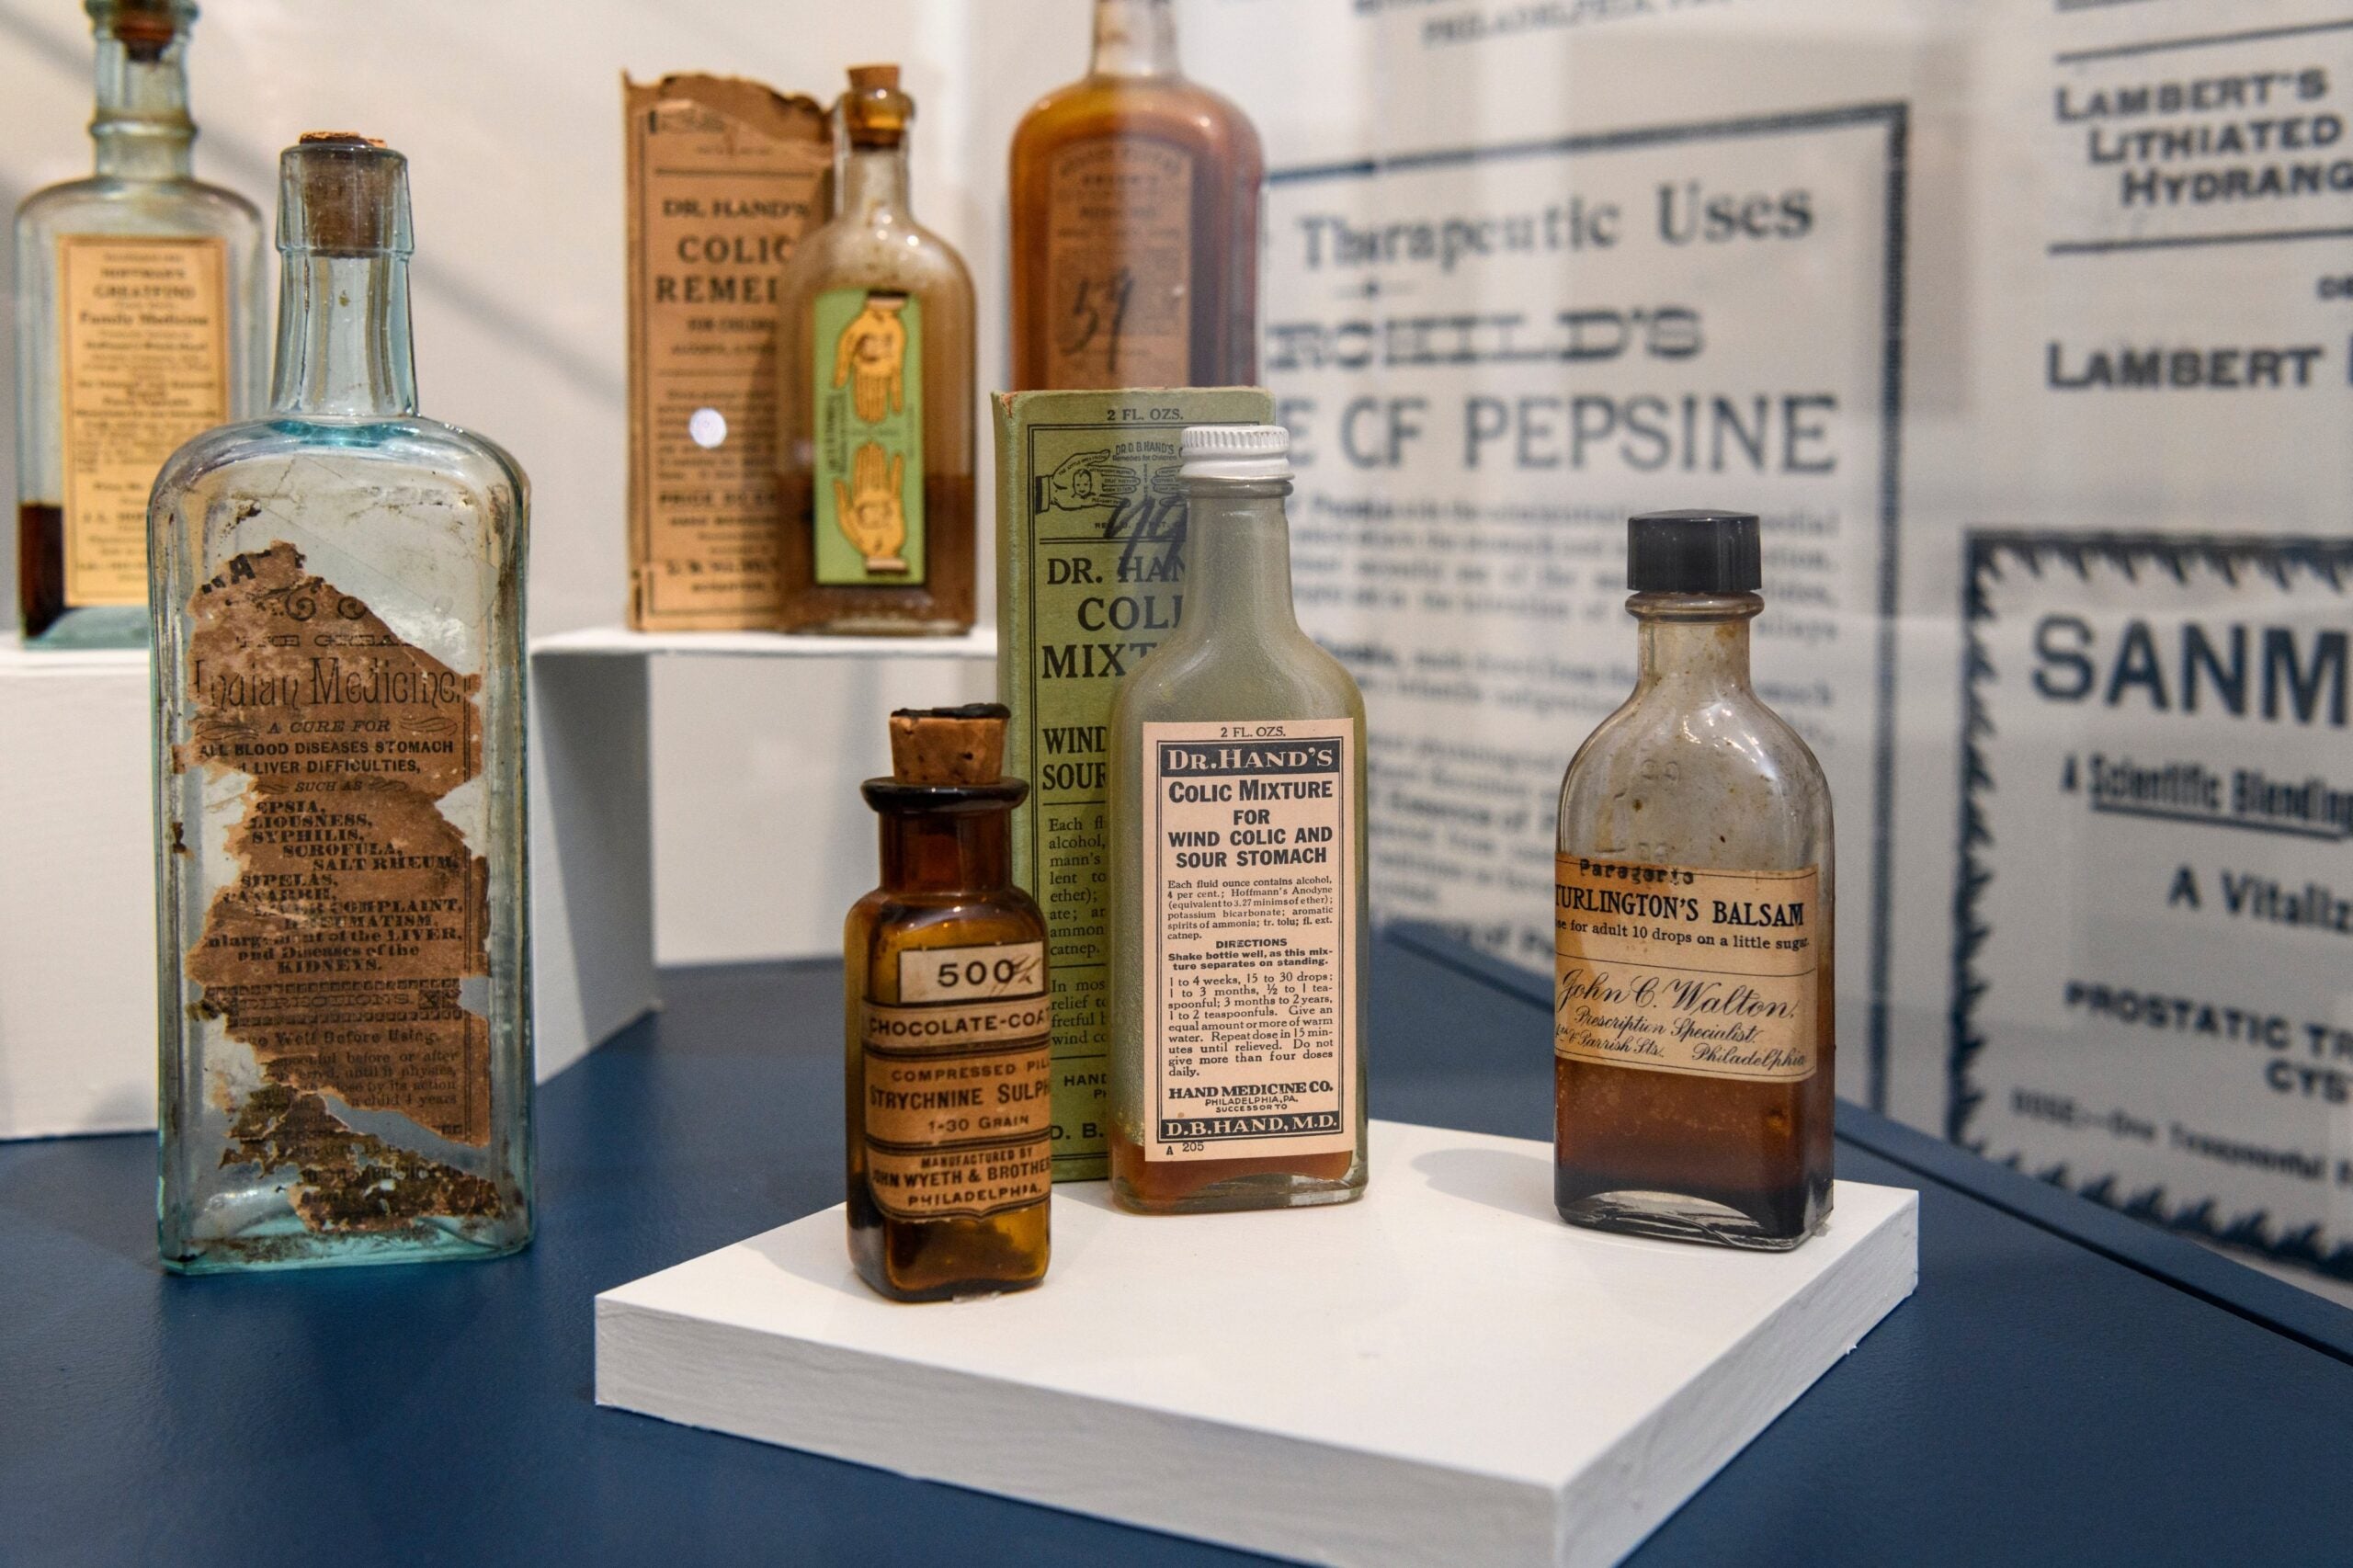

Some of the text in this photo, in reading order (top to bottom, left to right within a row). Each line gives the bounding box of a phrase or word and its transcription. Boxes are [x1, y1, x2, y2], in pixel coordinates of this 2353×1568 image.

[2054, 67, 2328, 122] LAMBERT'S
[2088, 114, 2343, 165] LITHIATED
[1298, 181, 1816, 273] Therapeutic Uses
[676, 235, 794, 265] COLIC
[2045, 340, 2325, 390] LAMBERT
[1108, 408, 1184, 421] 2 FL. OZS.
[1462, 392, 1838, 474] PEPSINE
[1048, 558, 1103, 585] DR.
[2031, 613, 2350, 729] SANM
[267, 720, 391, 734] A CURE FOR
[1221, 726, 1286, 738] 2 FL. OZS.
[234, 741, 289, 756] BLOOD
[295, 742, 369, 755] DISEASES
[375, 740, 453, 754] STOMACH
[255, 759, 421, 775] LIVER DIFFICULTIES,
[295, 782, 335, 793] SUCH
[2088, 752, 2224, 811] Scientific
[1169, 779, 1333, 803] COLIC MIXTURE
[1049, 818, 1083, 832] Each
[1233, 810, 1270, 825] FOR
[1049, 835, 1105, 850] alcohol,
[1168, 826, 1333, 847] WIND COLIC AND
[313, 858, 366, 871] SALT
[1050, 853, 1101, 867] mann's
[1176, 847, 1326, 868] SOUR STOMACH
[1050, 872, 1077, 885] lent
[1168, 881, 1192, 889] Each
[1197, 880, 1218, 888] fluid
[1254, 878, 1292, 887] contains
[1296, 876, 1332, 885] alcohol,
[1051, 888, 1097, 903] ether);
[1177, 892, 1192, 900] per
[1232, 888, 1288, 897] Hoffmann's
[1292, 887, 1332, 895] Anodyne
[1168, 901, 1222, 910] (equivalent
[1234, 899, 1252, 907] 3.27
[1555, 884, 1804, 927] TURLINGTON'S BALSAM
[1167, 907, 1333, 920] potassium bicarbonate; aromatic
[1167, 922, 1198, 930] spirits
[1199, 921, 1211, 929] of
[1212, 920, 1259, 928] ammonia;
[1278, 918, 1299, 926] tolu;
[1315, 916, 1332, 925] ext.
[1167, 932, 1202, 940] catnep.
[1571, 920, 1589, 933] for
[1592, 924, 1628, 937] adult
[1632, 926, 1647, 938] 10
[1652, 926, 1692, 946] drops
[1697, 935, 1714, 946] on
[1721, 937, 1728, 947] a
[1733, 935, 1770, 949] little
[1050, 943, 1099, 959] catnep.
[1216, 938, 1287, 949] DIRECTIONS
[1206, 951, 1238, 960] bottle
[1242, 949, 1267, 960] well,
[1285, 949, 1306, 957] this
[1310, 948, 1333, 956] mix-
[1173, 962, 1197, 971] ture
[1200, 960, 1256, 970] separates
[1278, 958, 1328, 966] standing.
[938, 959, 1015, 987] 500
[1558, 969, 1630, 1012] John
[1630, 974, 1659, 1009] C.
[1051, 996, 1088, 1010] relief
[1051, 1013, 1095, 1028] fretful
[2064, 979, 2292, 1052] PROSTATIC
[1574, 1006, 1665, 1036] Prescription
[1670, 1017, 1764, 1044] Specialist.
[1051, 1031, 1087, 1045] wind
[1577, 1031, 1632, 1053] Parrish
[1691, 1042, 1805, 1072] Philadelphia
[891, 1062, 1017, 1083] COMPRESSED
[1168, 1081, 1334, 1098] HAND MEDICINE CO.
[1216, 1105, 1273, 1113] SUCCESSOR
[928, 1114, 1029, 1133] 1-30 GRAIN
[1166, 1142, 1204, 1155] A 205
[921, 1147, 1032, 1168] MANUFACTURED BY
[905, 1170, 962, 1187] WYETH
[968, 1169, 982, 1183] &
[908, 1183, 1042, 1207] PHILADELPHIA.
